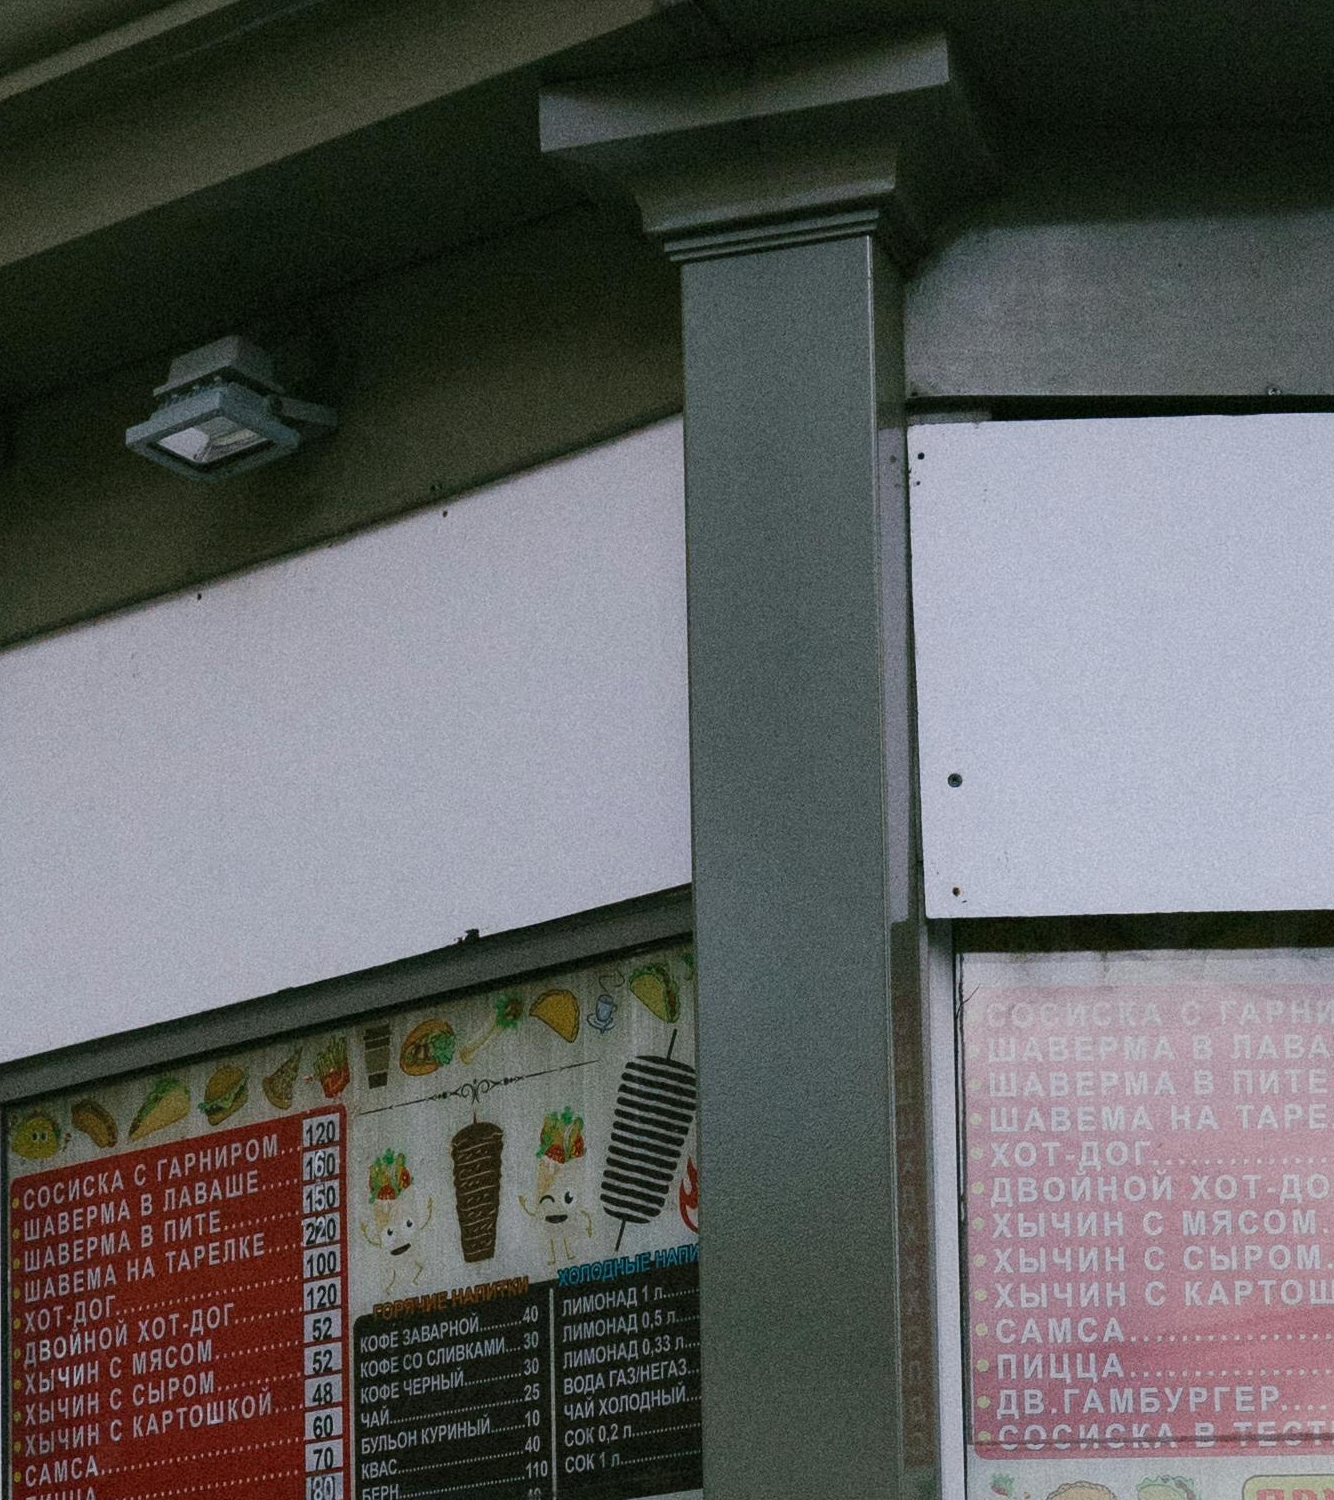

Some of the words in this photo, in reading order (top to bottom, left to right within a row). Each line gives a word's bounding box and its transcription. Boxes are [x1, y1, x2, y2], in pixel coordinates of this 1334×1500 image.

[23, 1168, 123, 1210] СОСИСКА
[134, 1163, 146, 1186] С
[157, 1134, 278, 1181] ГАРНИРОМ
[305, 1120, 335, 1147] 120
[990, 1141, 1152, 1172] ХОТ-ДОГ
[24, 1198, 130, 1240] ШАВЕРМА
[141, 1193, 152, 1216] В
[163, 1171, 258, 1212] ЛАВАШЕ
[305, 1151, 335, 1179] 160
[989, 1169, 1173, 1208] ДВОЙНОЙ
[24, 1229, 130, 1271] ШАВЕРМА
[141, 1225, 153, 1248] В
[164, 1211, 220, 1243] ПИТЕ
[305, 1184, 335, 1212] 150
[992, 1212, 1125, 1237] ХЫЧИН
[1143, 1211, 1164, 1235] С
[1182, 1209, 1317, 1235] МЯСОМ
[24, 1263, 116, 1302] ШАВЕМА
[127, 1256, 154, 1282] НА
[165, 1234, 264, 1274] ТАРЕЛКЕ
[993, 1247, 1126, 1273] ХЫЧИН
[1143, 1246, 1165, 1271] С
[1182, 1244, 1322, 1270] СЫРОМ
[994, 1282, 1127, 1308] ХЫЧИН
[1144, 1281, 1166, 1306] С
[996, 1318, 1125, 1344] САМСА
[997, 1353, 1124, 1384] ПИЦЦА
[996, 1386, 1281, 1419] ДВ.ГАМБУРГЕР
[998, 1423, 1173, 1450] СОСИСКА
[1194, 1423, 1215, 1447] В
